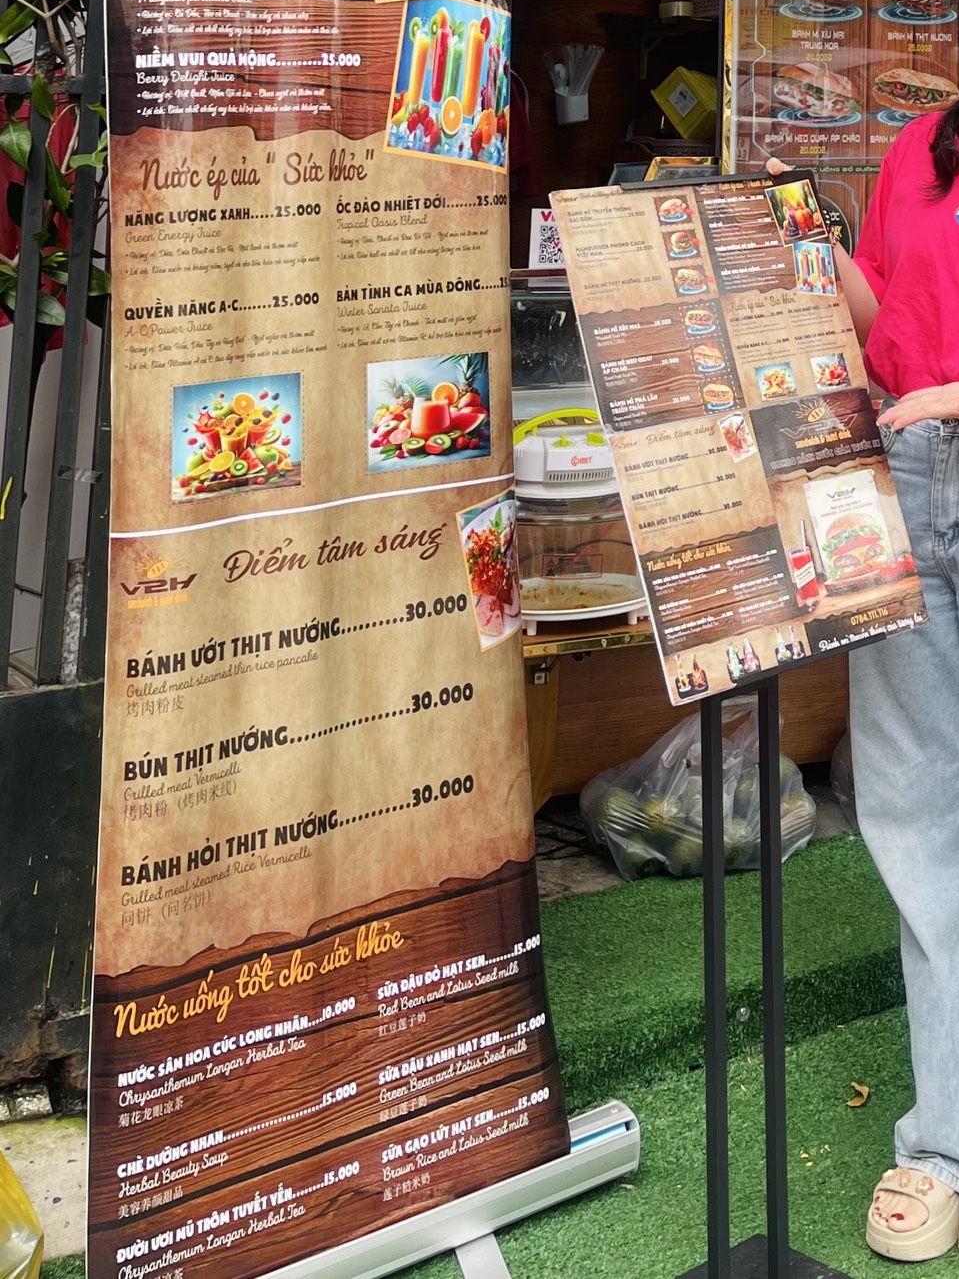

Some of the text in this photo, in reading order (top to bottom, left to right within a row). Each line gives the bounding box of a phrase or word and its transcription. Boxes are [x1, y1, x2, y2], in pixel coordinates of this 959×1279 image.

[136, 46, 174, 68] NIỀM
[178, 53, 204, 66] VUI
[207, 48, 236, 66] QUẢ
[140, 157, 201, 191] Nước
[207, 156, 228, 200] ép
[231, 156, 260, 185] của
[284, 152, 325, 185] Sức
[125, 209, 165, 226] NĂNG
[169, 208, 216, 226] LƯỢNG
[336, 195, 352, 214] ỐC
[354, 196, 381, 213] ĐẢO
[384, 196, 420, 216] NHIỆT
[125, 298, 174, 321] QUYỀN
[178, 300, 216, 315] NĂNG
[336, 285, 358, 302] BẢN
[362, 283, 391, 299] TÌNH
[394, 284, 412, 296] CA
[415, 279, 442, 295] MÙA
[223, 523, 448, 583] Điểm tâm sáng
[120, 572, 198, 595] V2H
[127, 649, 185, 678] BÁNH
[191, 637, 226, 668] ƯỚT
[231, 631, 272, 658] THỊT
[127, 649, 319, 698] Grilled meat steamed thin rice pancake
[124, 751, 167, 781] BÚN
[175, 743, 214, 772] THỊT
[124, 761, 242, 801] Grilled meat Vermicelli
[121, 854, 182, 886] BÁNH
[187, 837, 220, 869] HỎI
[226, 828, 268, 857] THỊT
[114, 921, 404, 1038] Nước uống tốt cho sức khỏe
[378, 979, 398, 999] SỮA
[401, 973, 423, 993] ĐẬU
[425, 965, 440, 984] ĐỎ
[443, 958, 465, 977] HẠT
[118, 1063, 155, 1088] NƯỚC
[158, 1055, 183, 1078] SÂM
[186, 1047, 211, 1067] HOA
[213, 1035, 237, 1057] CÚC
[239, 1026, 272, 1049] LONG
[117, 1156, 144, 1178] CHÈ
[146, 1146, 188, 1170] DƯỠNG
